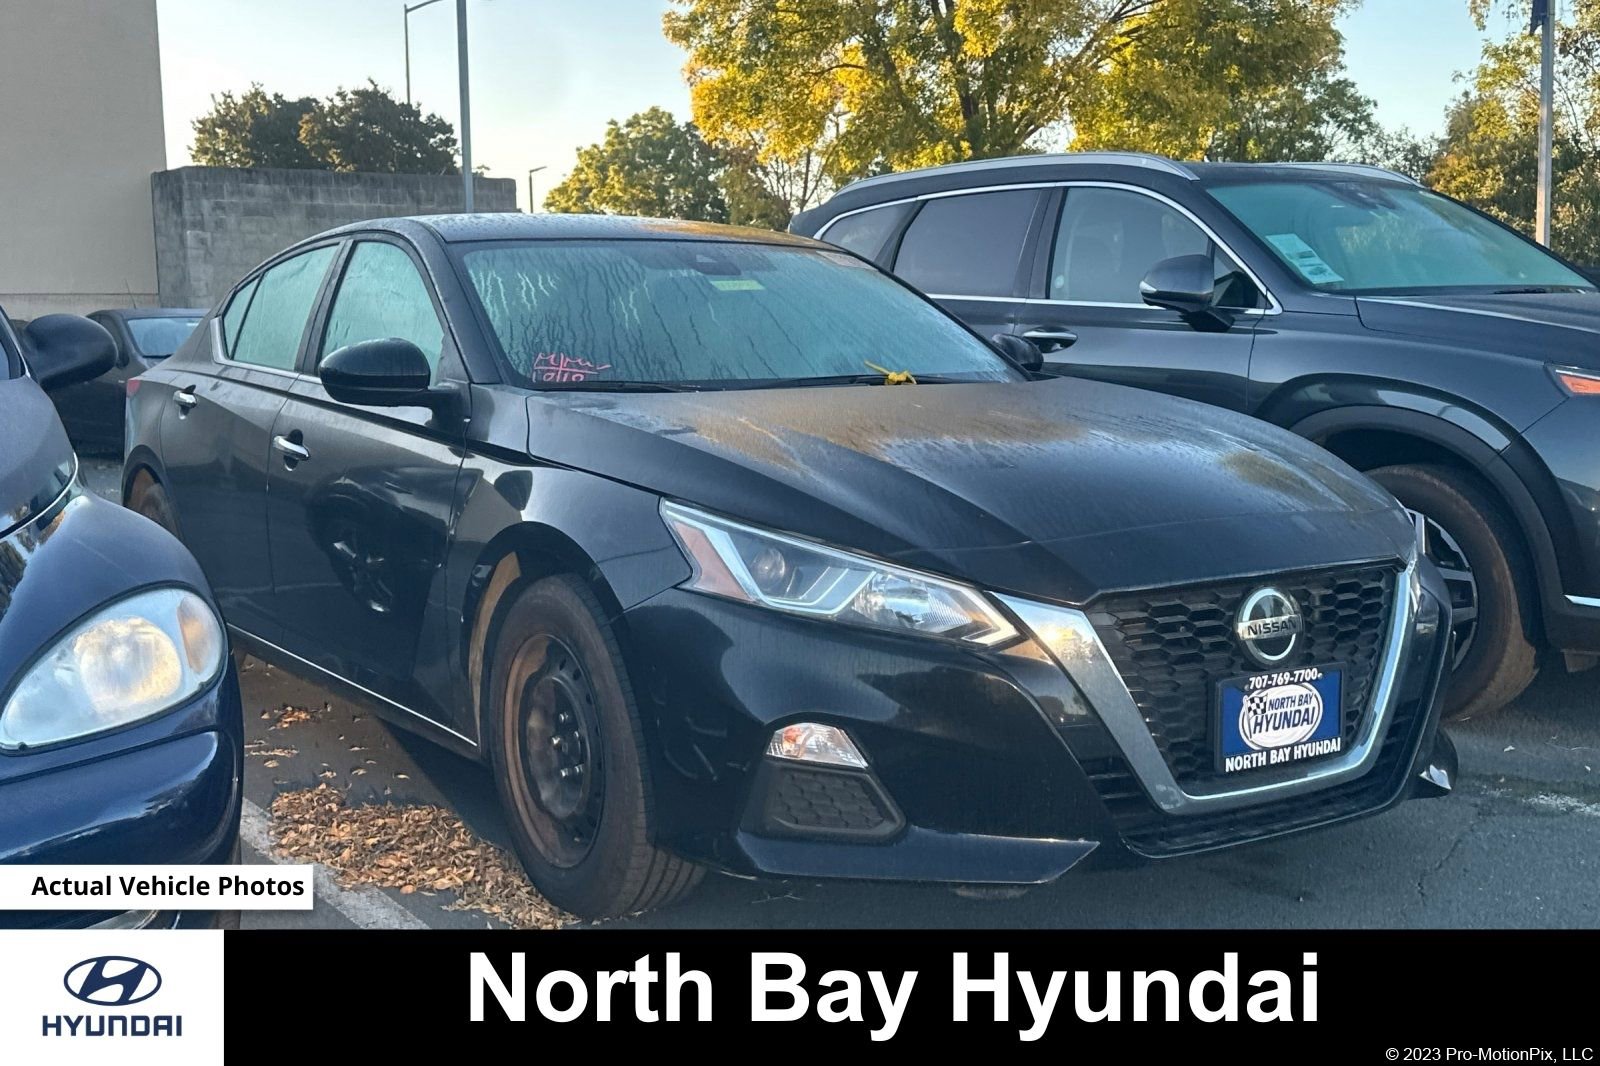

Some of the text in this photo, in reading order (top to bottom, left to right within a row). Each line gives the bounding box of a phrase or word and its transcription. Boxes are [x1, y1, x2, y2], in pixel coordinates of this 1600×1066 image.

[1247, 618, 1298, 636] NISSAN
[1249, 668, 1318, 690] 707-769-7700
[1268, 693, 1314, 711] NORTH BAY
[1253, 707, 1315, 734] HYUNDAI
[1225, 737, 1341, 772] NORTH BAY HYUNDAI
